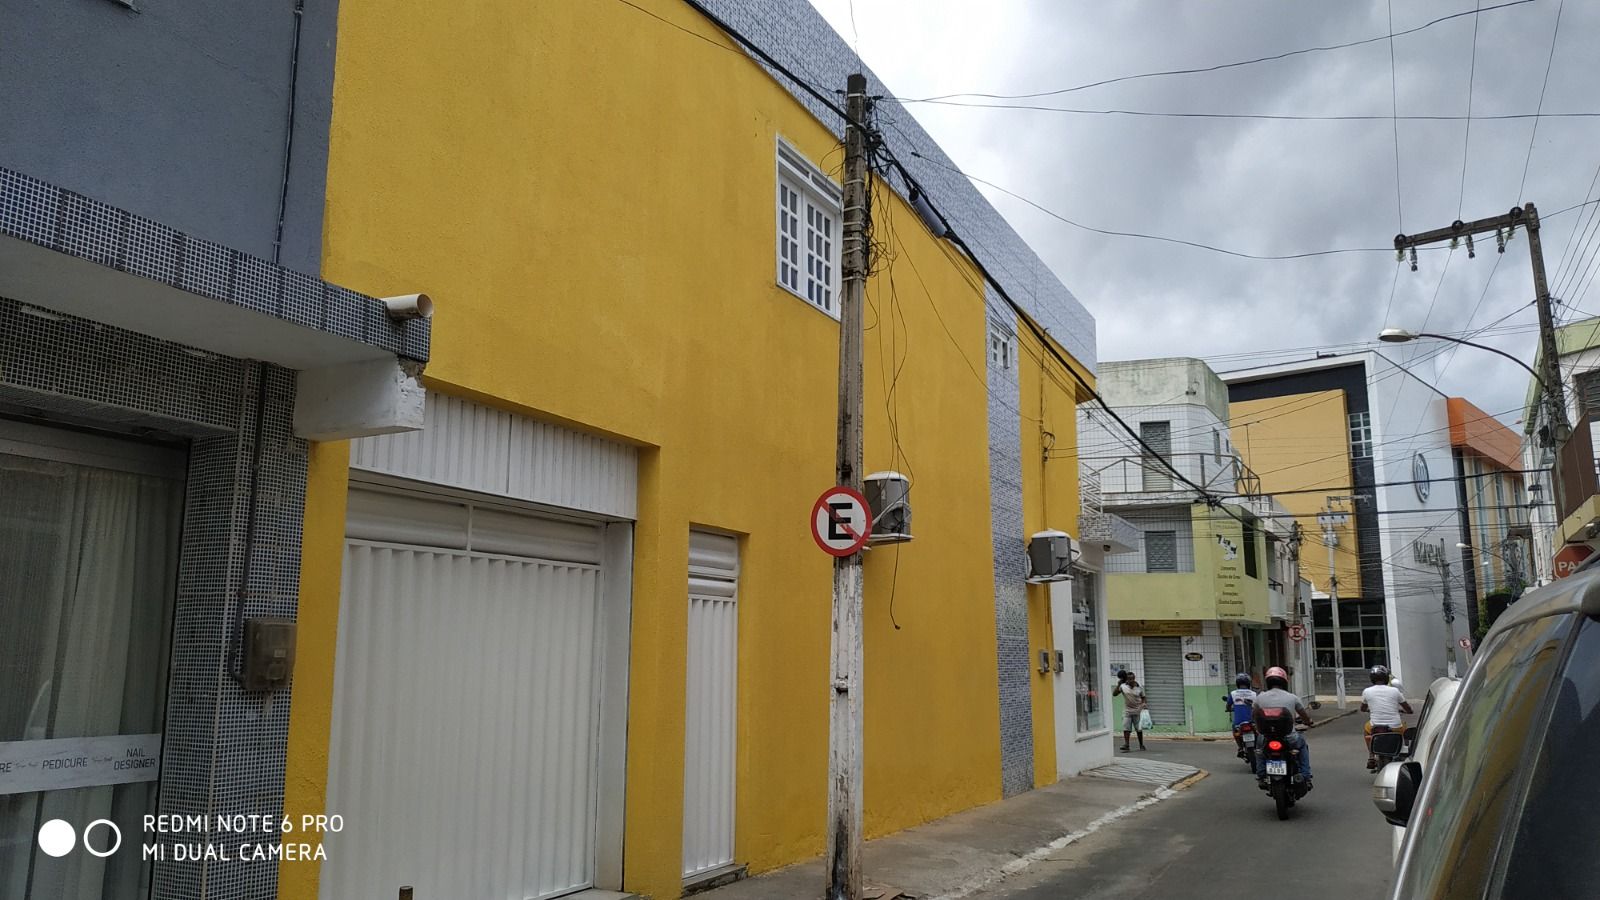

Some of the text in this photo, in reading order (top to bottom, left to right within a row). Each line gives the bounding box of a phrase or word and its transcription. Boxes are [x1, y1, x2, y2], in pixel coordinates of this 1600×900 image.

[828, 502, 853, 541] E
[126, 748, 146, 758] NAIL
[42, 757, 89, 770] PEDICURE
[113, 758, 156, 771] DESIGNER
